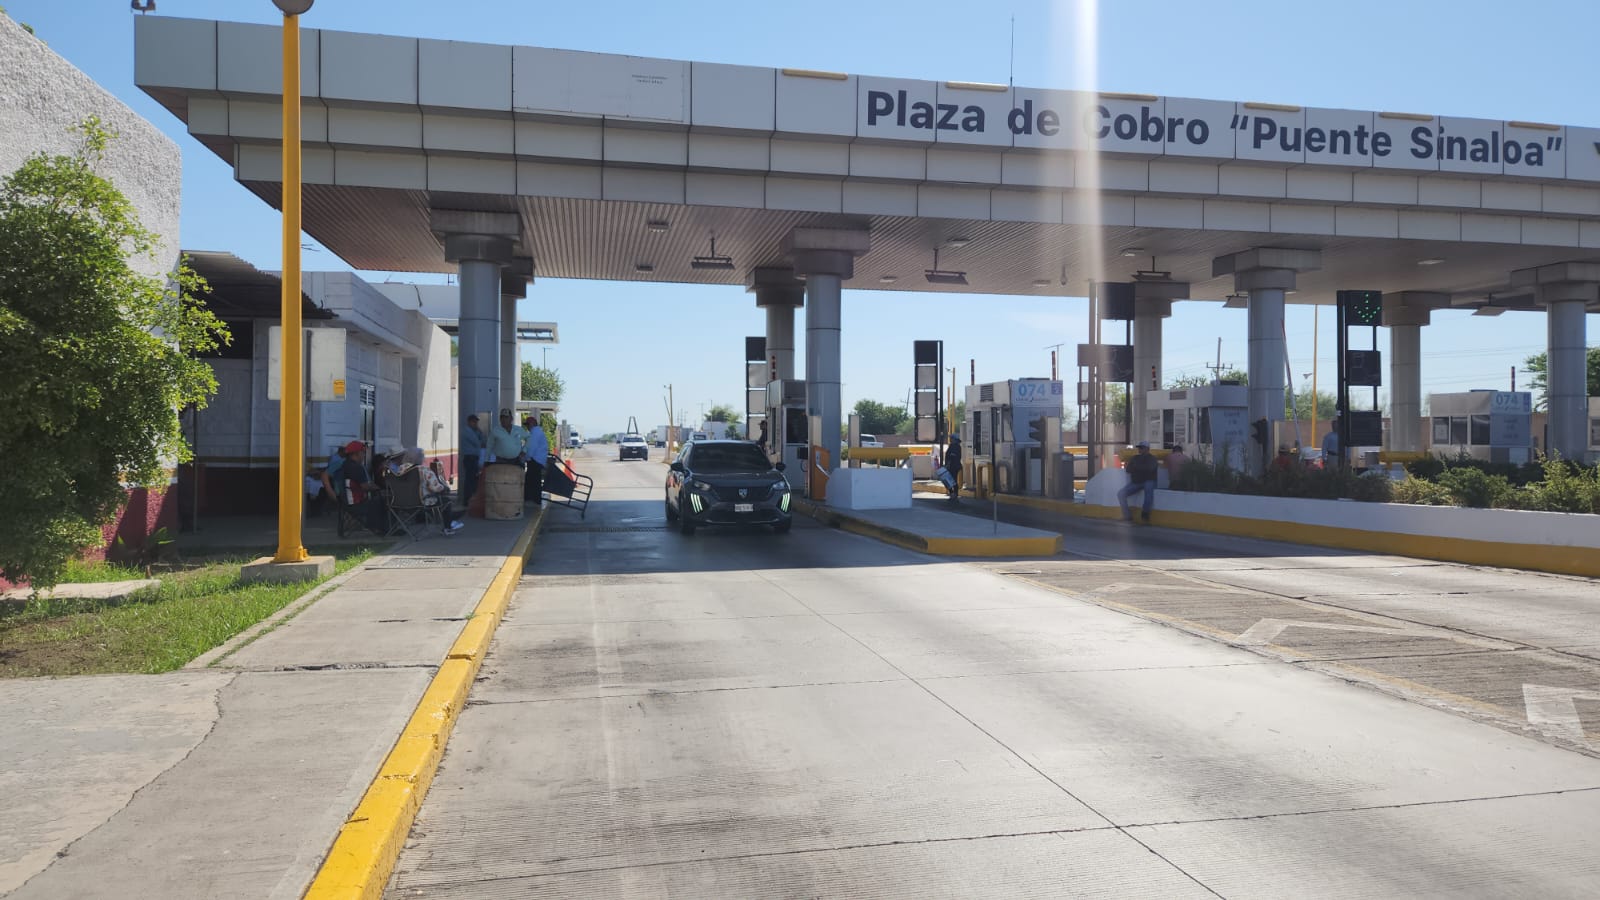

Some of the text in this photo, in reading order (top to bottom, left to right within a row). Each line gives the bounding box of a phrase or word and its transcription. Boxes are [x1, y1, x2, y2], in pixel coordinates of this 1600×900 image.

[867, 89, 1563, 167] Plaza de Cobro “Puente Sinaloa”
[1018, 383, 1046, 397] 074
